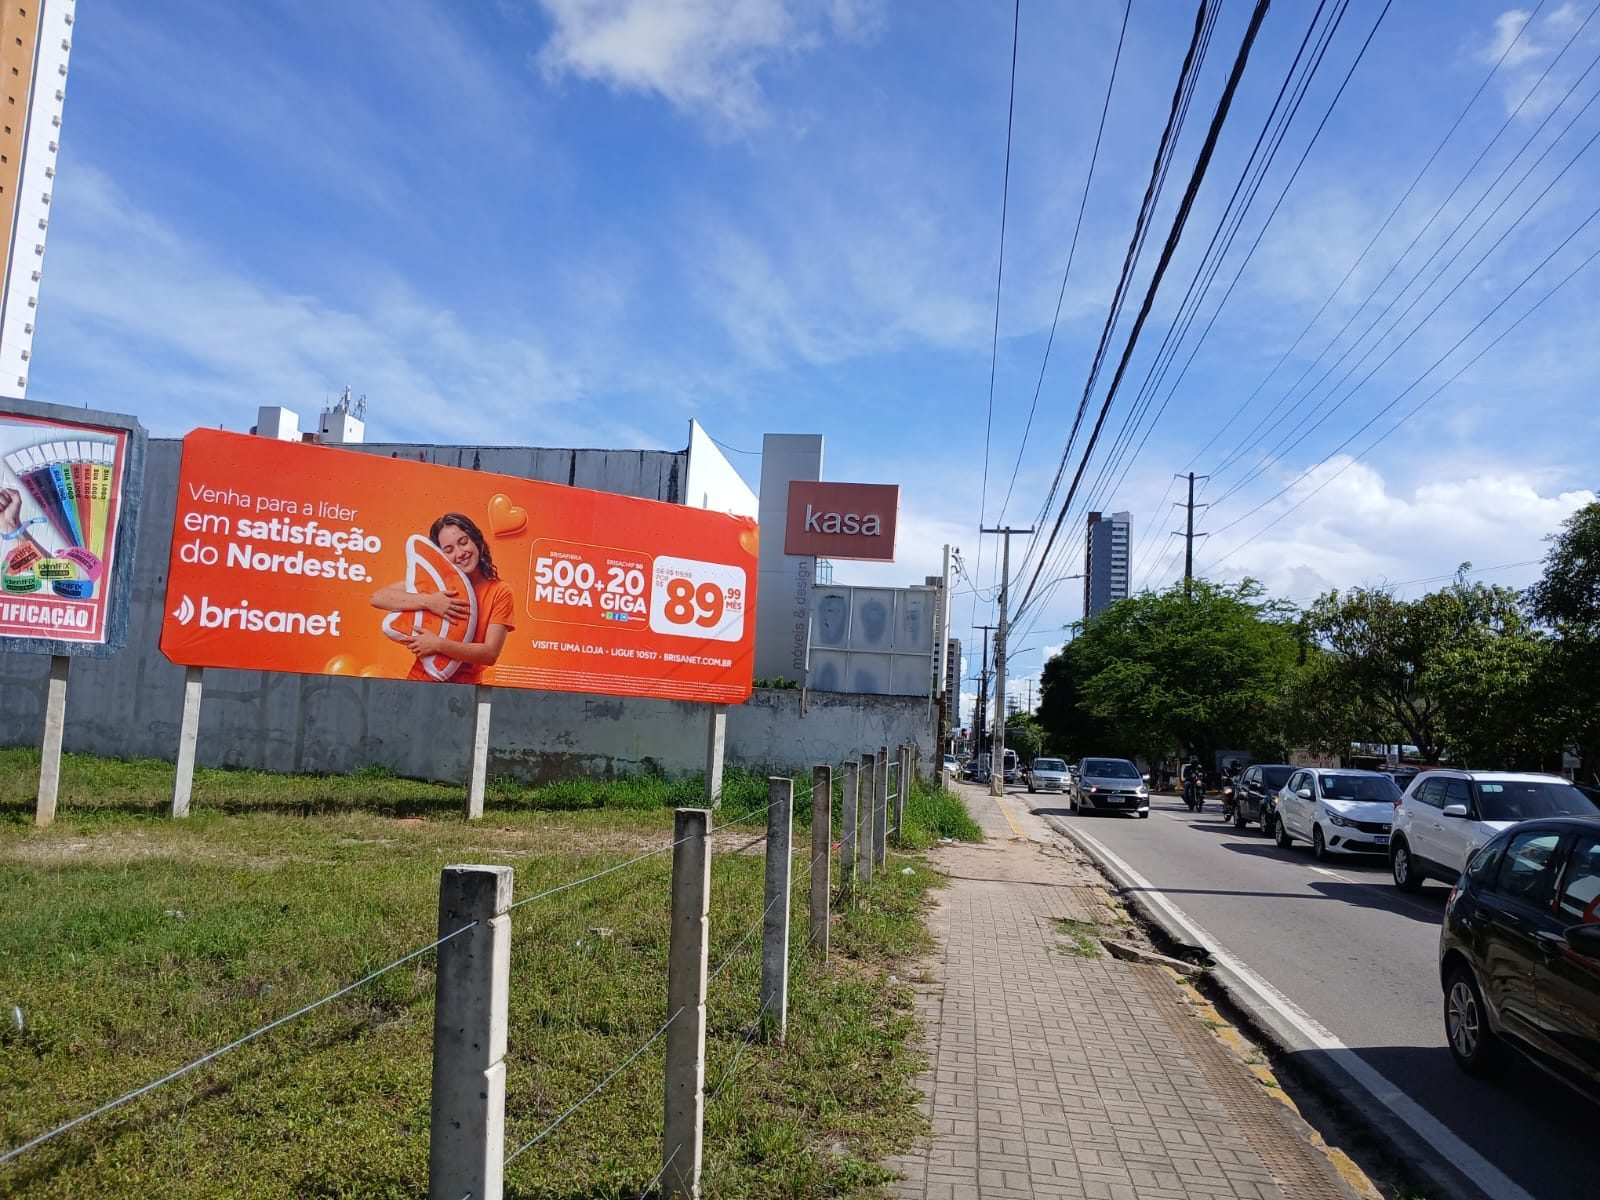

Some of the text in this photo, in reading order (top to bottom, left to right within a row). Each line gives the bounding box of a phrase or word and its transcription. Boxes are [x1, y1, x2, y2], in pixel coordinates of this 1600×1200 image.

[66, 483, 75, 500] LOGO
[189, 482, 358, 521] Venha para a líder
[184, 512, 381, 555] em satisfação
[804, 504, 881, 536] kasa
[180, 538, 373, 583] do Nordeste.
[534, 557, 595, 590] 500
[606, 567, 645, 596] 20
[199, 596, 341, 637] brisanet
[535, 584, 647, 614] MEGA GIGA
[664, 578, 724, 628] 89
[725, 600, 742, 610] MÊS
[791, 561, 810, 670] móveis & design
[531, 639, 732, 668] VISITE UMA LOJA LIGUE 10517 BRISANET.COM.BR
